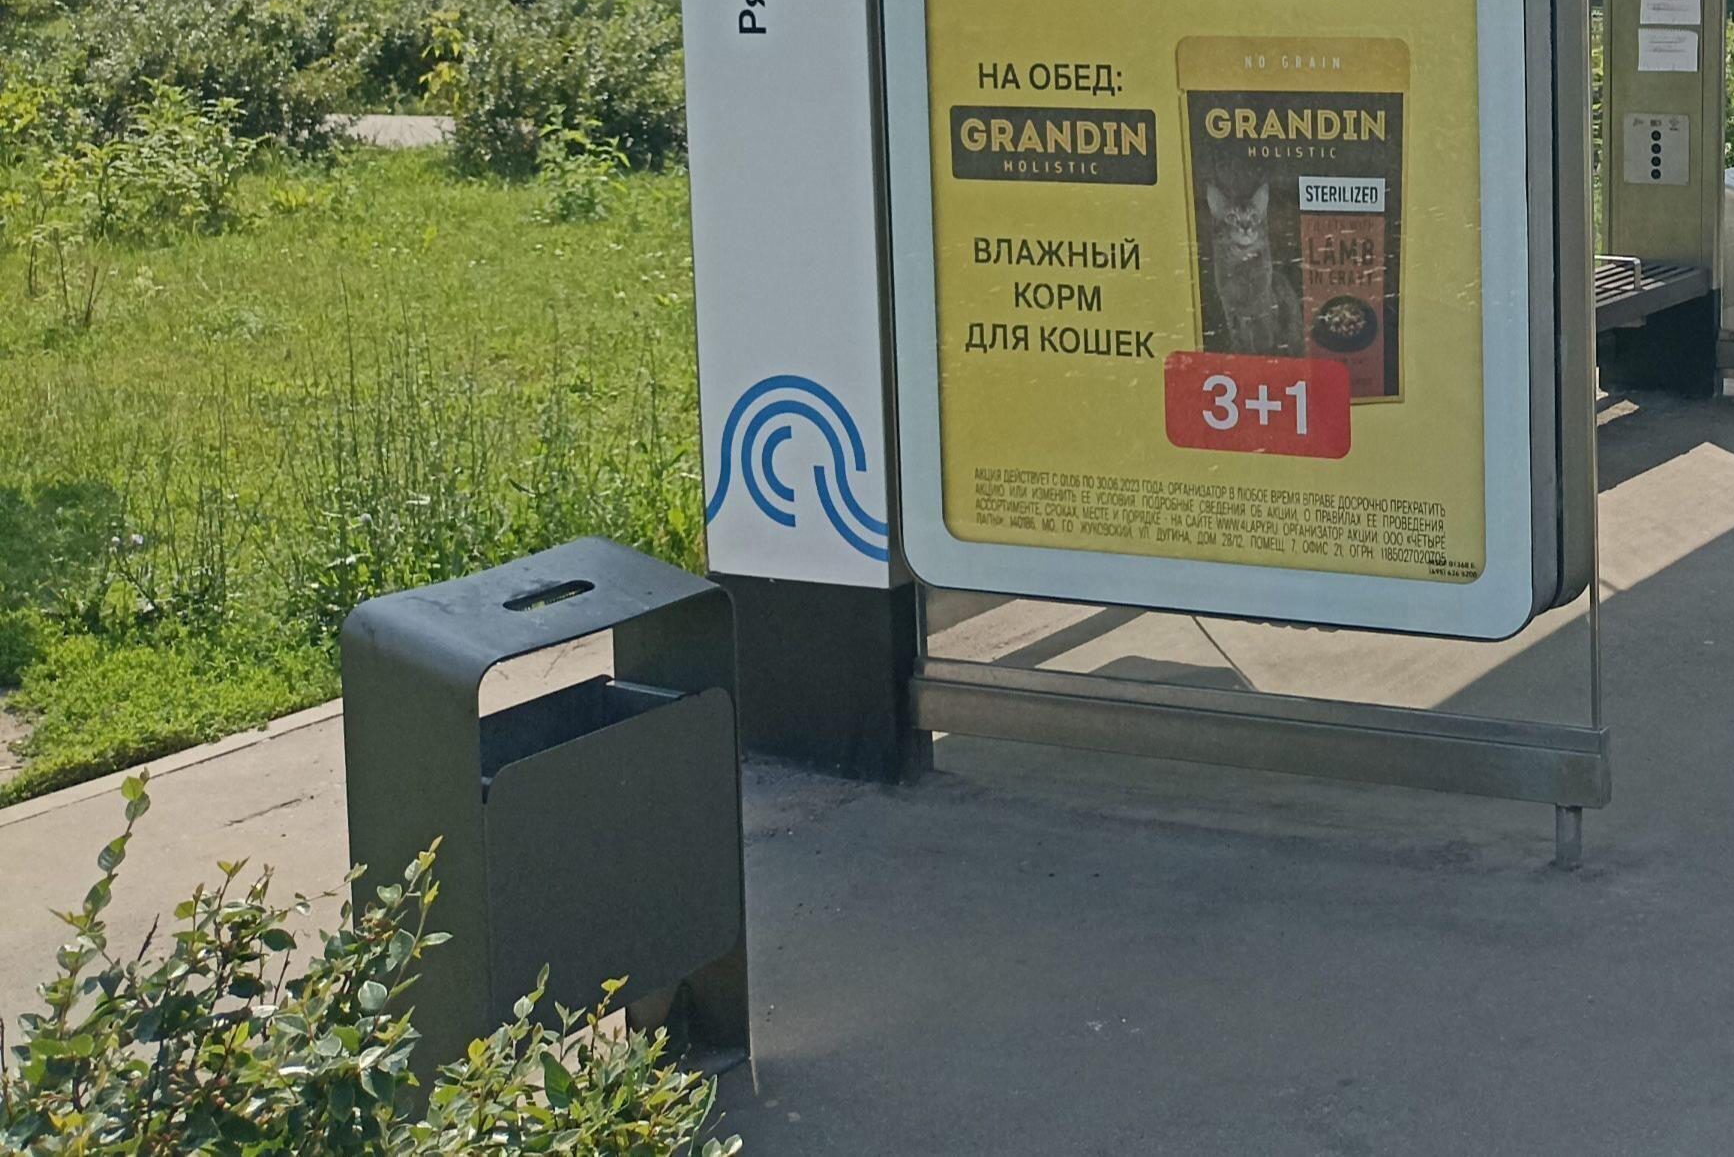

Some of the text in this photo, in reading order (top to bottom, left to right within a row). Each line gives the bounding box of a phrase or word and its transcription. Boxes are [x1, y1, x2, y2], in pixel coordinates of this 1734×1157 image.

[978, 63, 1124, 95] НА ОБЕД:
[1244, 55, 1341, 70] NO GRAIN
[960, 119, 1147, 157] GRANDIN
[1205, 108, 1386, 143] GRANDIN
[1004, 161, 1099, 176] HOLISTIC
[1248, 146, 1337, 160] HOLISTIC
[1306, 185, 1378, 204] STERILIZED
[974, 236, 1142, 271] ВЛАЖНЫЙ
[1307, 237, 1374, 266] LAMB
[1013, 283, 1103, 313] КОРМ
[964, 324, 1155, 359] ДЛЯ КОШЕК
[1201, 376, 1309, 436] 3+1
[1004, 469, 1049, 485] ДЕЙСТВУЕТ
[1083, 475, 1095, 488] ПО
[1168, 482, 1226, 499] ОРГАНИЗАТОР
[1229, 487, 1235, 500] В
[1237, 487, 1268, 503] ЛЮБОЕ
[1271, 490, 1300, 505] ВРЕМЯ
[1303, 493, 1335, 509] ВПРАВЕ
[1338, 495, 1388, 512] ДОСРОЧНО
[1390, 499, 1445, 517] ПРЕКРАТИТЬ
[1081, 490, 1091, 504] ЕЕ
[1142, 495, 1194, 512] ПОДРОБНЫЕ
[1200, 500, 1246, 516] СВЕДЕНИЯ
[1251, 504, 1262, 518] ОБ
[1316, 509, 1361, 526] ПРАВИЛАХ
[1367, 513, 1377, 528] ЕЕ
[1083, 506, 1109, 520] МЕСТЕ
[1123, 509, 1161, 526] ПОРЯДКЕ
[1171, 513, 1183, 526] НА
[1186, 514, 1212, 530] САЙТЕ
[1283, 523, 1344, 540] ОРГАНИЗАТОР
[1383, 531, 1404, 547] ООО
[1197, 531, 1216, 545] ДОМ
[1303, 539, 1329, 555] ОФИС
